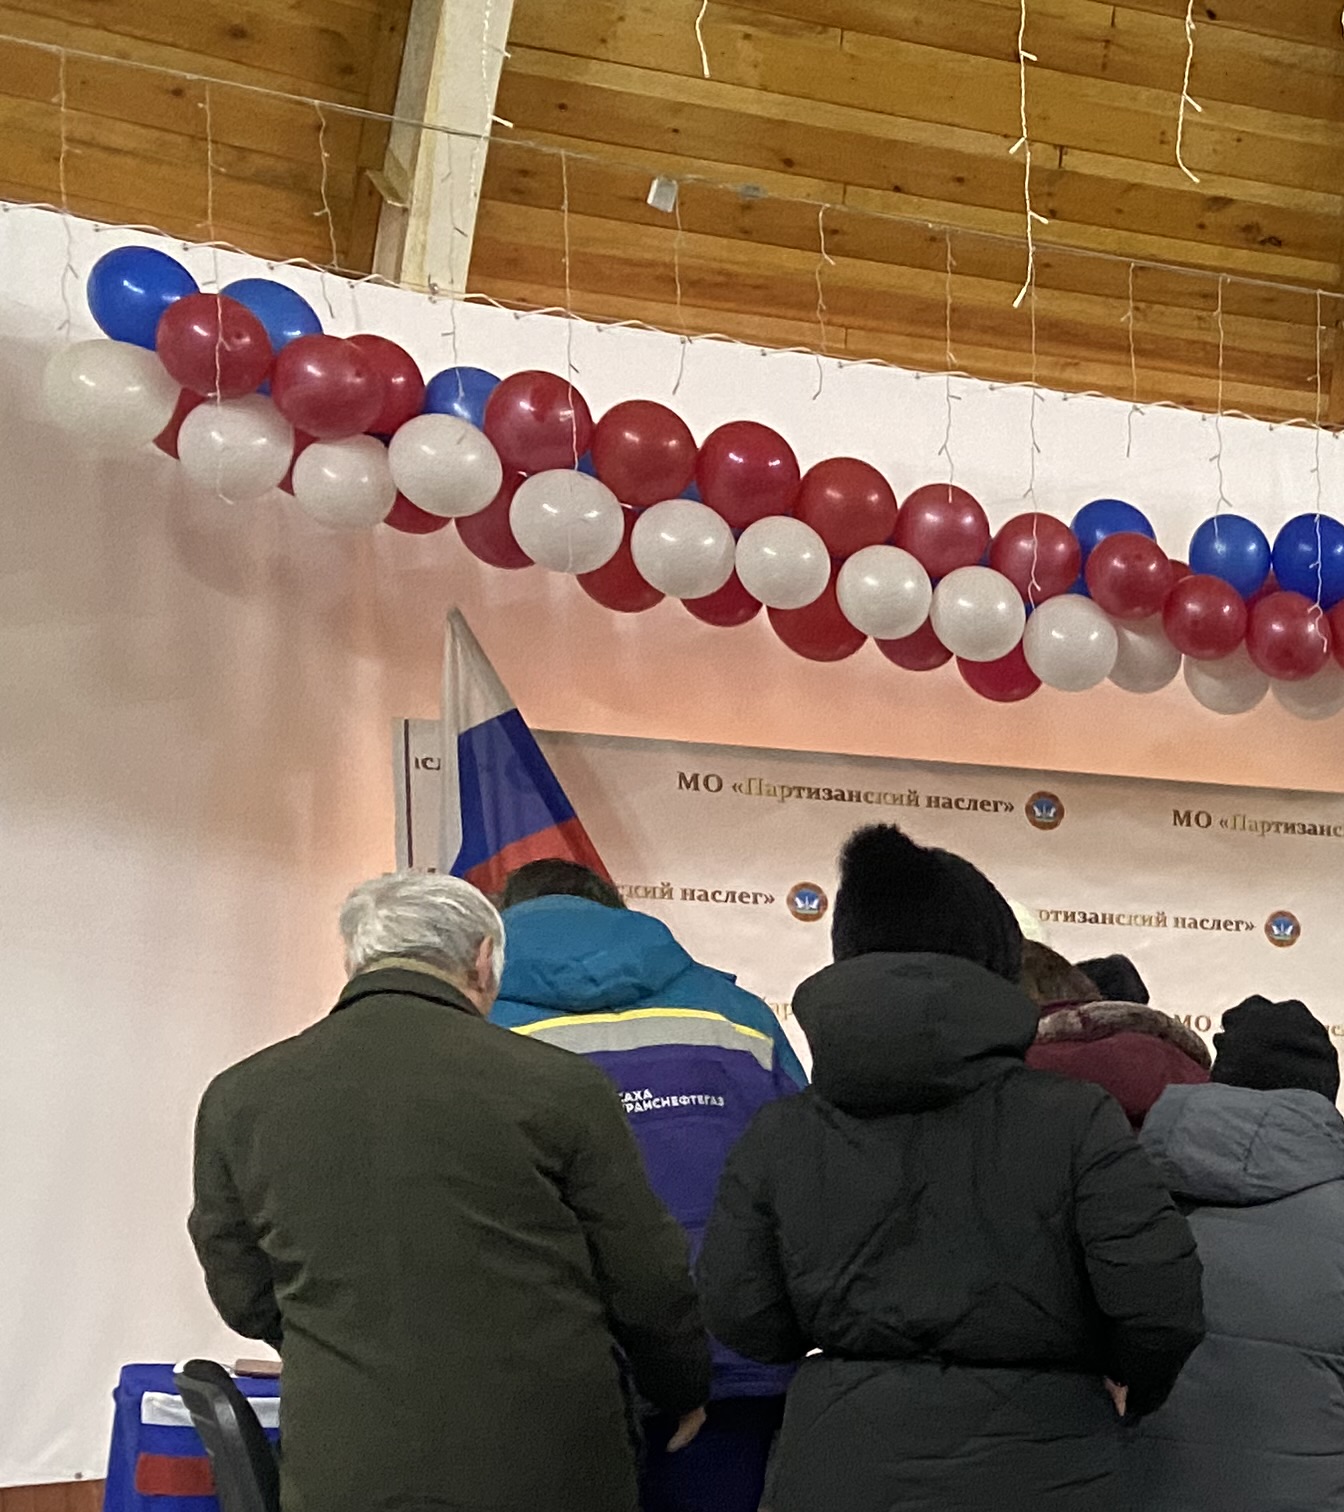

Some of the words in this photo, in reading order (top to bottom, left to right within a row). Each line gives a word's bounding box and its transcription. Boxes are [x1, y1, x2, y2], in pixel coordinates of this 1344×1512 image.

[678, 771, 723, 793] МО
[732, 777, 920, 807] «Партизанский
[926, 794, 1015, 812] наслег»
[1172, 809, 1212, 828] МО
[680, 887, 775, 904] наслег»
[1174, 915, 1254, 932] наслег»
[624, 1095, 724, 1113] РАНСНЕФТЕГАЗ
